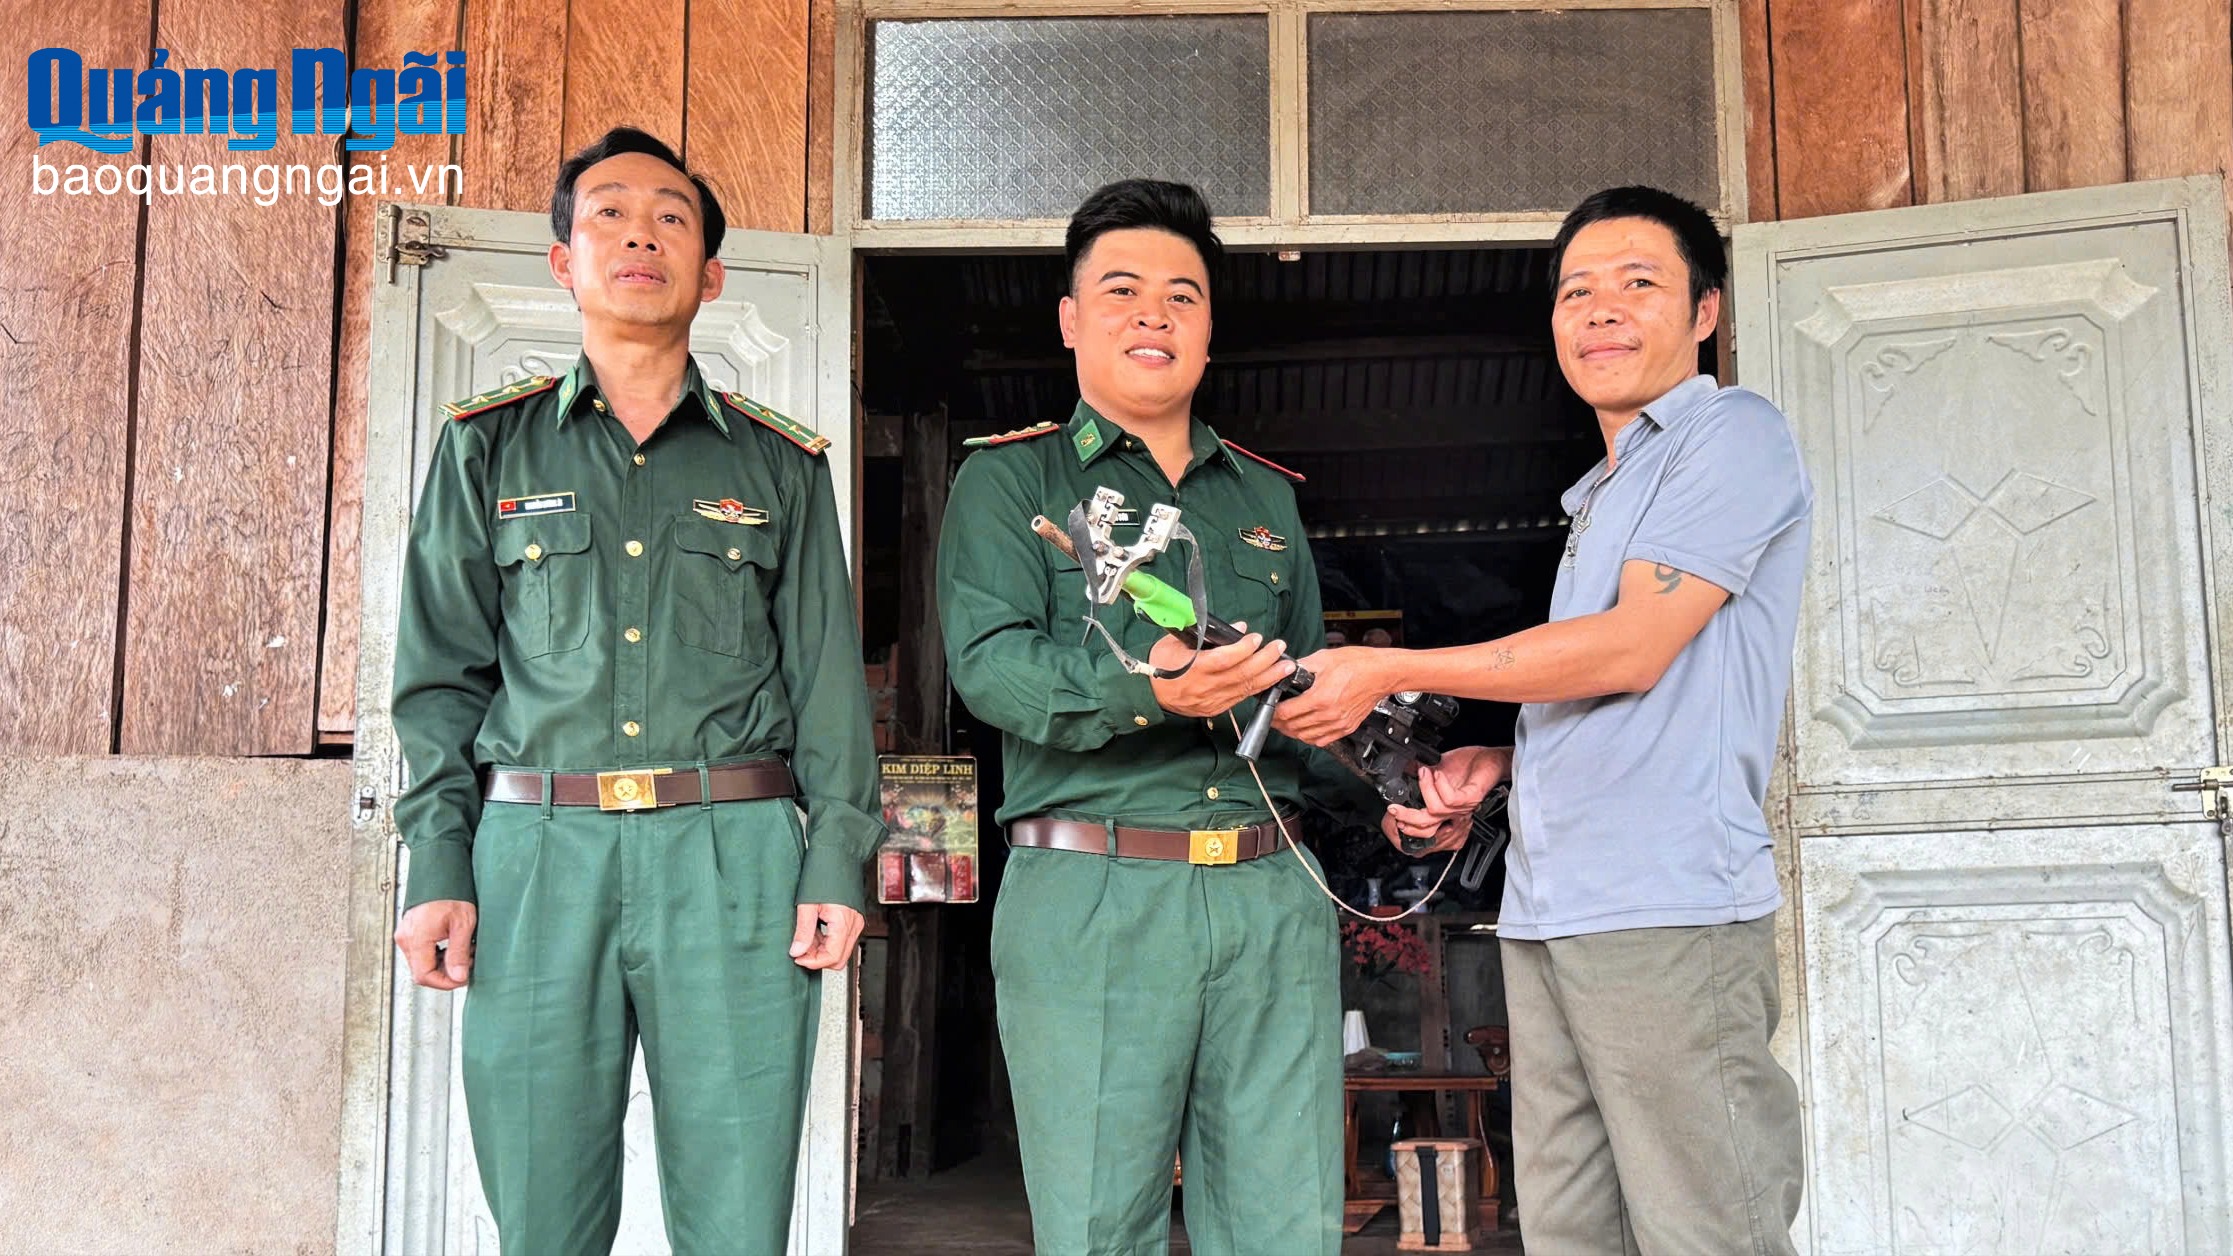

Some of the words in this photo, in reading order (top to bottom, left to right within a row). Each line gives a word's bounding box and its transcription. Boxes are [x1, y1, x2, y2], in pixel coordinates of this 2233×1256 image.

[882, 763, 906, 774] KIM
[910, 762, 939, 775] DIỆP
[943, 763, 972, 774] LINH
